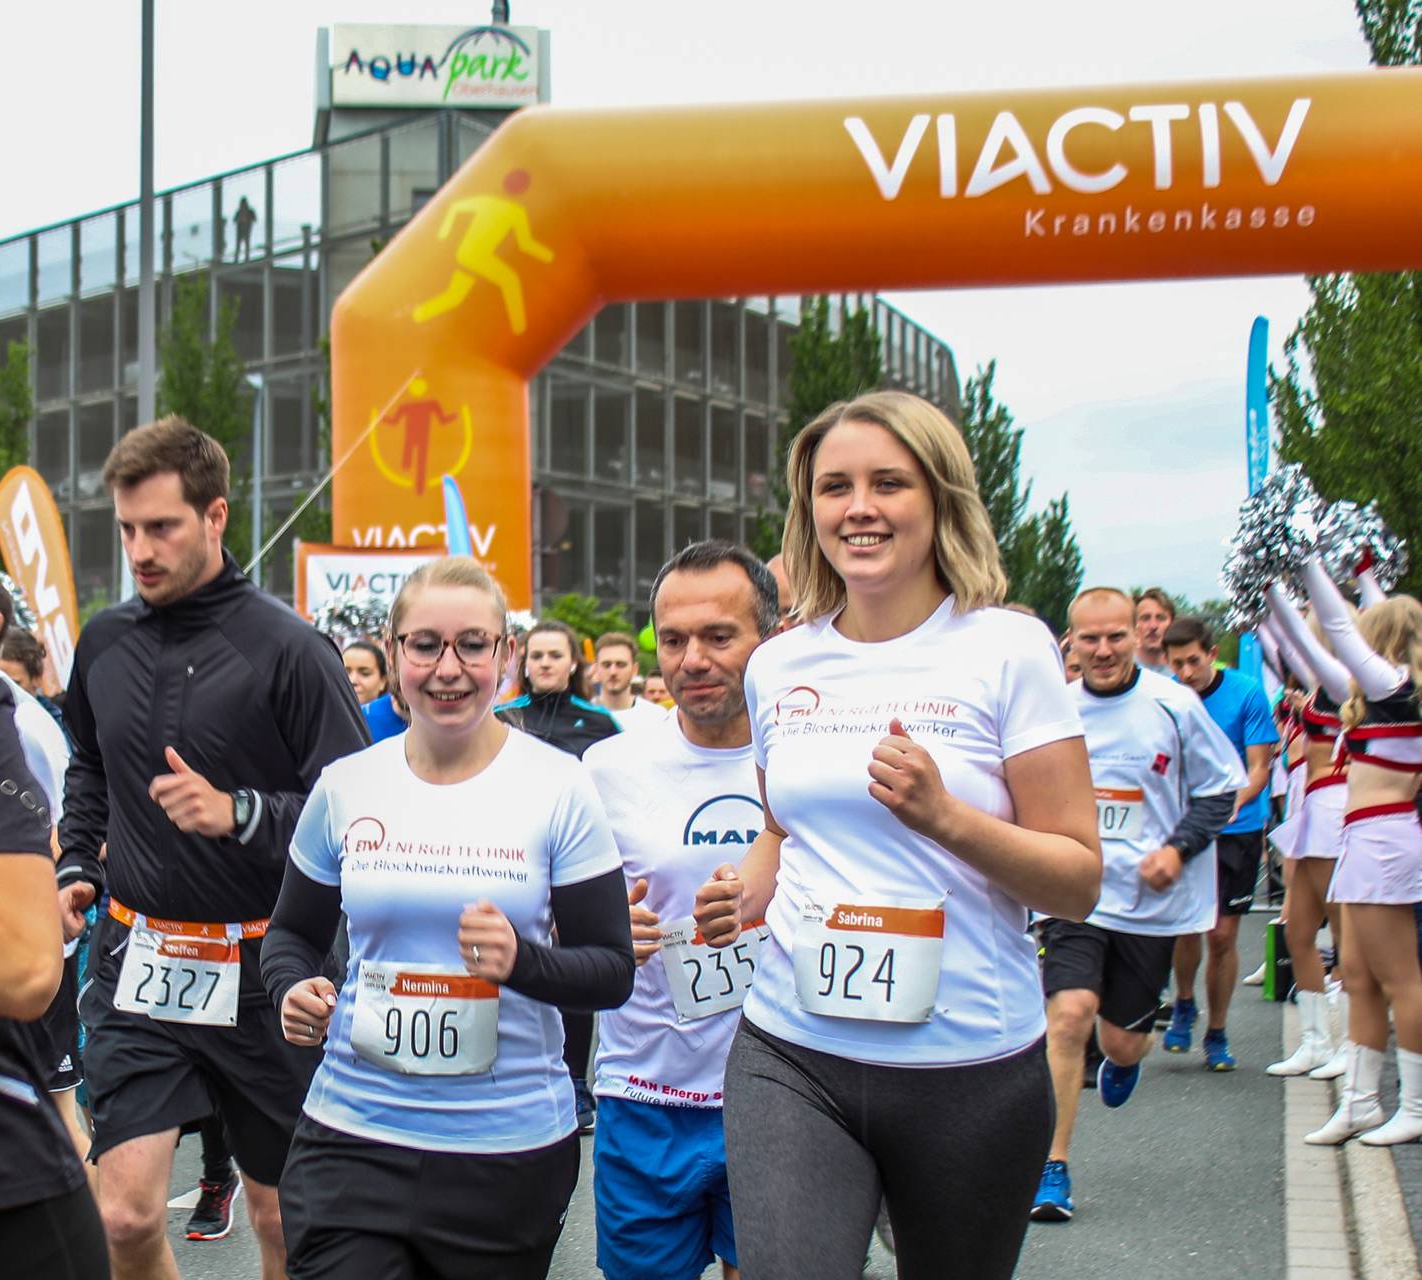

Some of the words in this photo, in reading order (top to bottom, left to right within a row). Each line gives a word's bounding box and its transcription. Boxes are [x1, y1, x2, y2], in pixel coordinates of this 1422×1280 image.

[344, 48, 437, 84] AQUA
[443, 44, 529, 102] park
[842, 97, 1312, 202] VIACTIV
[1025, 201, 1318, 238] Krankenkasse
[1097, 805, 1130, 831] 07
[355, 839, 382, 853] ETW
[373, 859, 529, 884] Blockheizkraftwerker
[837, 910, 883, 928] Sabrina
[817, 941, 896, 1003] 924
[134, 961, 221, 1012] 2327
[401, 979, 450, 995] Nermina
[383, 1006, 459, 1059] 906
[622, 1086, 660, 1106] Future
[628, 1075, 659, 1092] MAN
[661, 1085, 710, 1103] Energy
